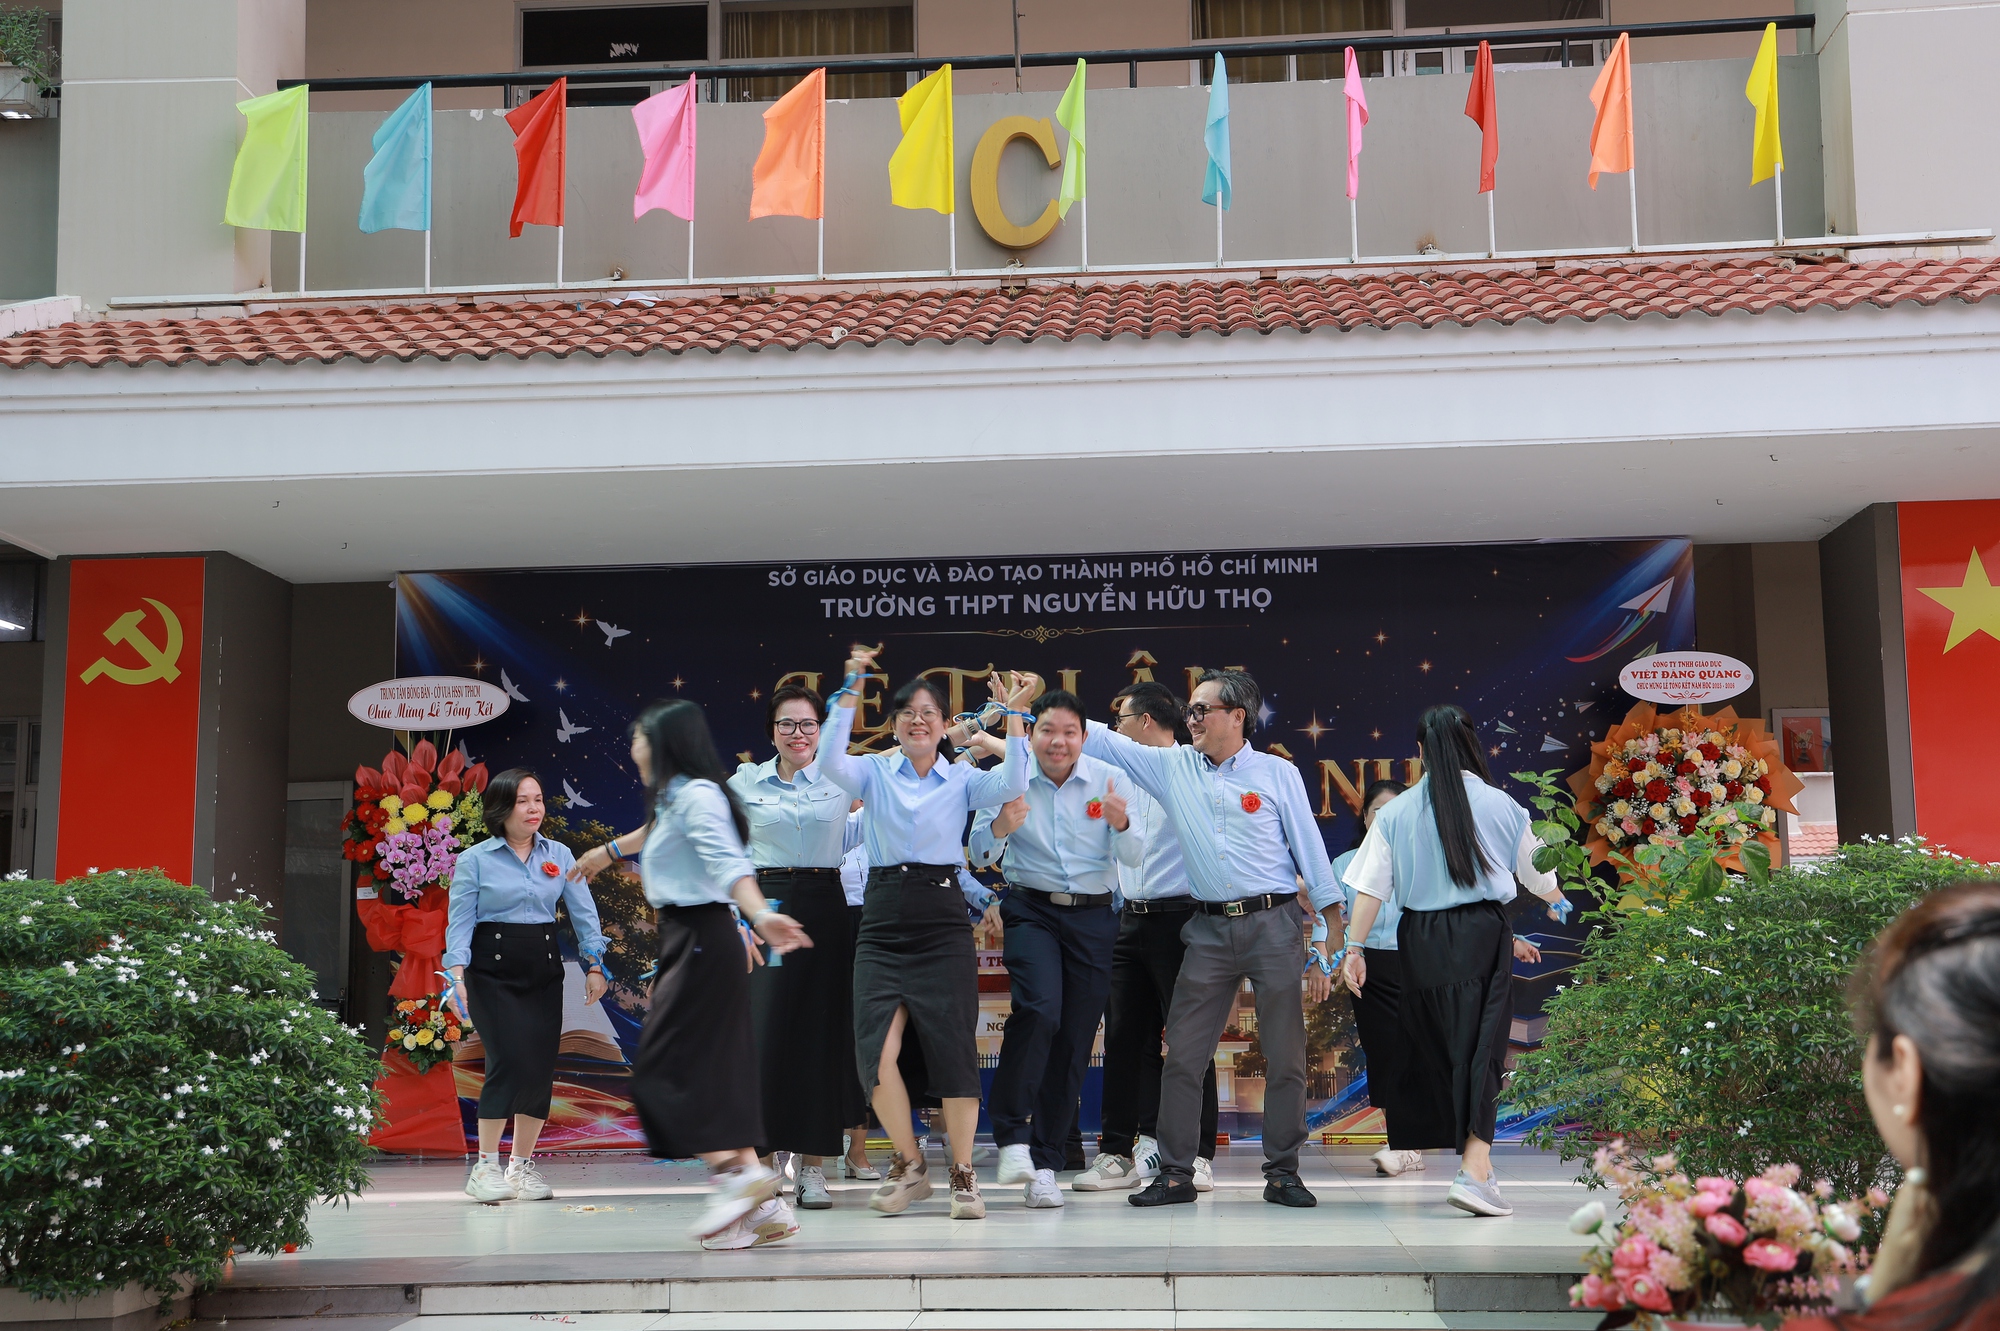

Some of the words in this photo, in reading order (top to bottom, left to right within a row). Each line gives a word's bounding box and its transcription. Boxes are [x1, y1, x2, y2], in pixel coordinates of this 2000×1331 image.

[970, 115, 1061, 249] C
[768, 565, 797, 587] SỞ
[804, 565, 856, 586] GIÁO
[863, 567, 906, 588] DỤC
[913, 563, 941, 583] VÀ
[948, 562, 994, 583] ĐÀO
[1001, 564, 1043, 585] TẠO
[1049, 558, 1123, 580] THÀNH
[1131, 555, 1175, 578] PHỐ
[1182, 554, 1214, 576] HỒ
[1220, 554, 1256, 575] CHÍ
[1263, 557, 1318, 574] MINH
[820, 592, 936, 618] TRƯỜNG
[945, 594, 1014, 615] THPT
[1023, 583, 1136, 614] NGUYỄN
[1147, 584, 1205, 611] HỮU
[1215, 587, 1272, 614] THỌ
[1630, 669, 1659, 680] VIỆT
[1698, 670, 1742, 680] QUANG
[367, 703, 392, 719] Chúc
[394, 702, 424, 721] Mừng
[427, 701, 441, 717] Lễ
[444, 701, 471, 720] Tổng
[474, 700, 494, 717] Kết
